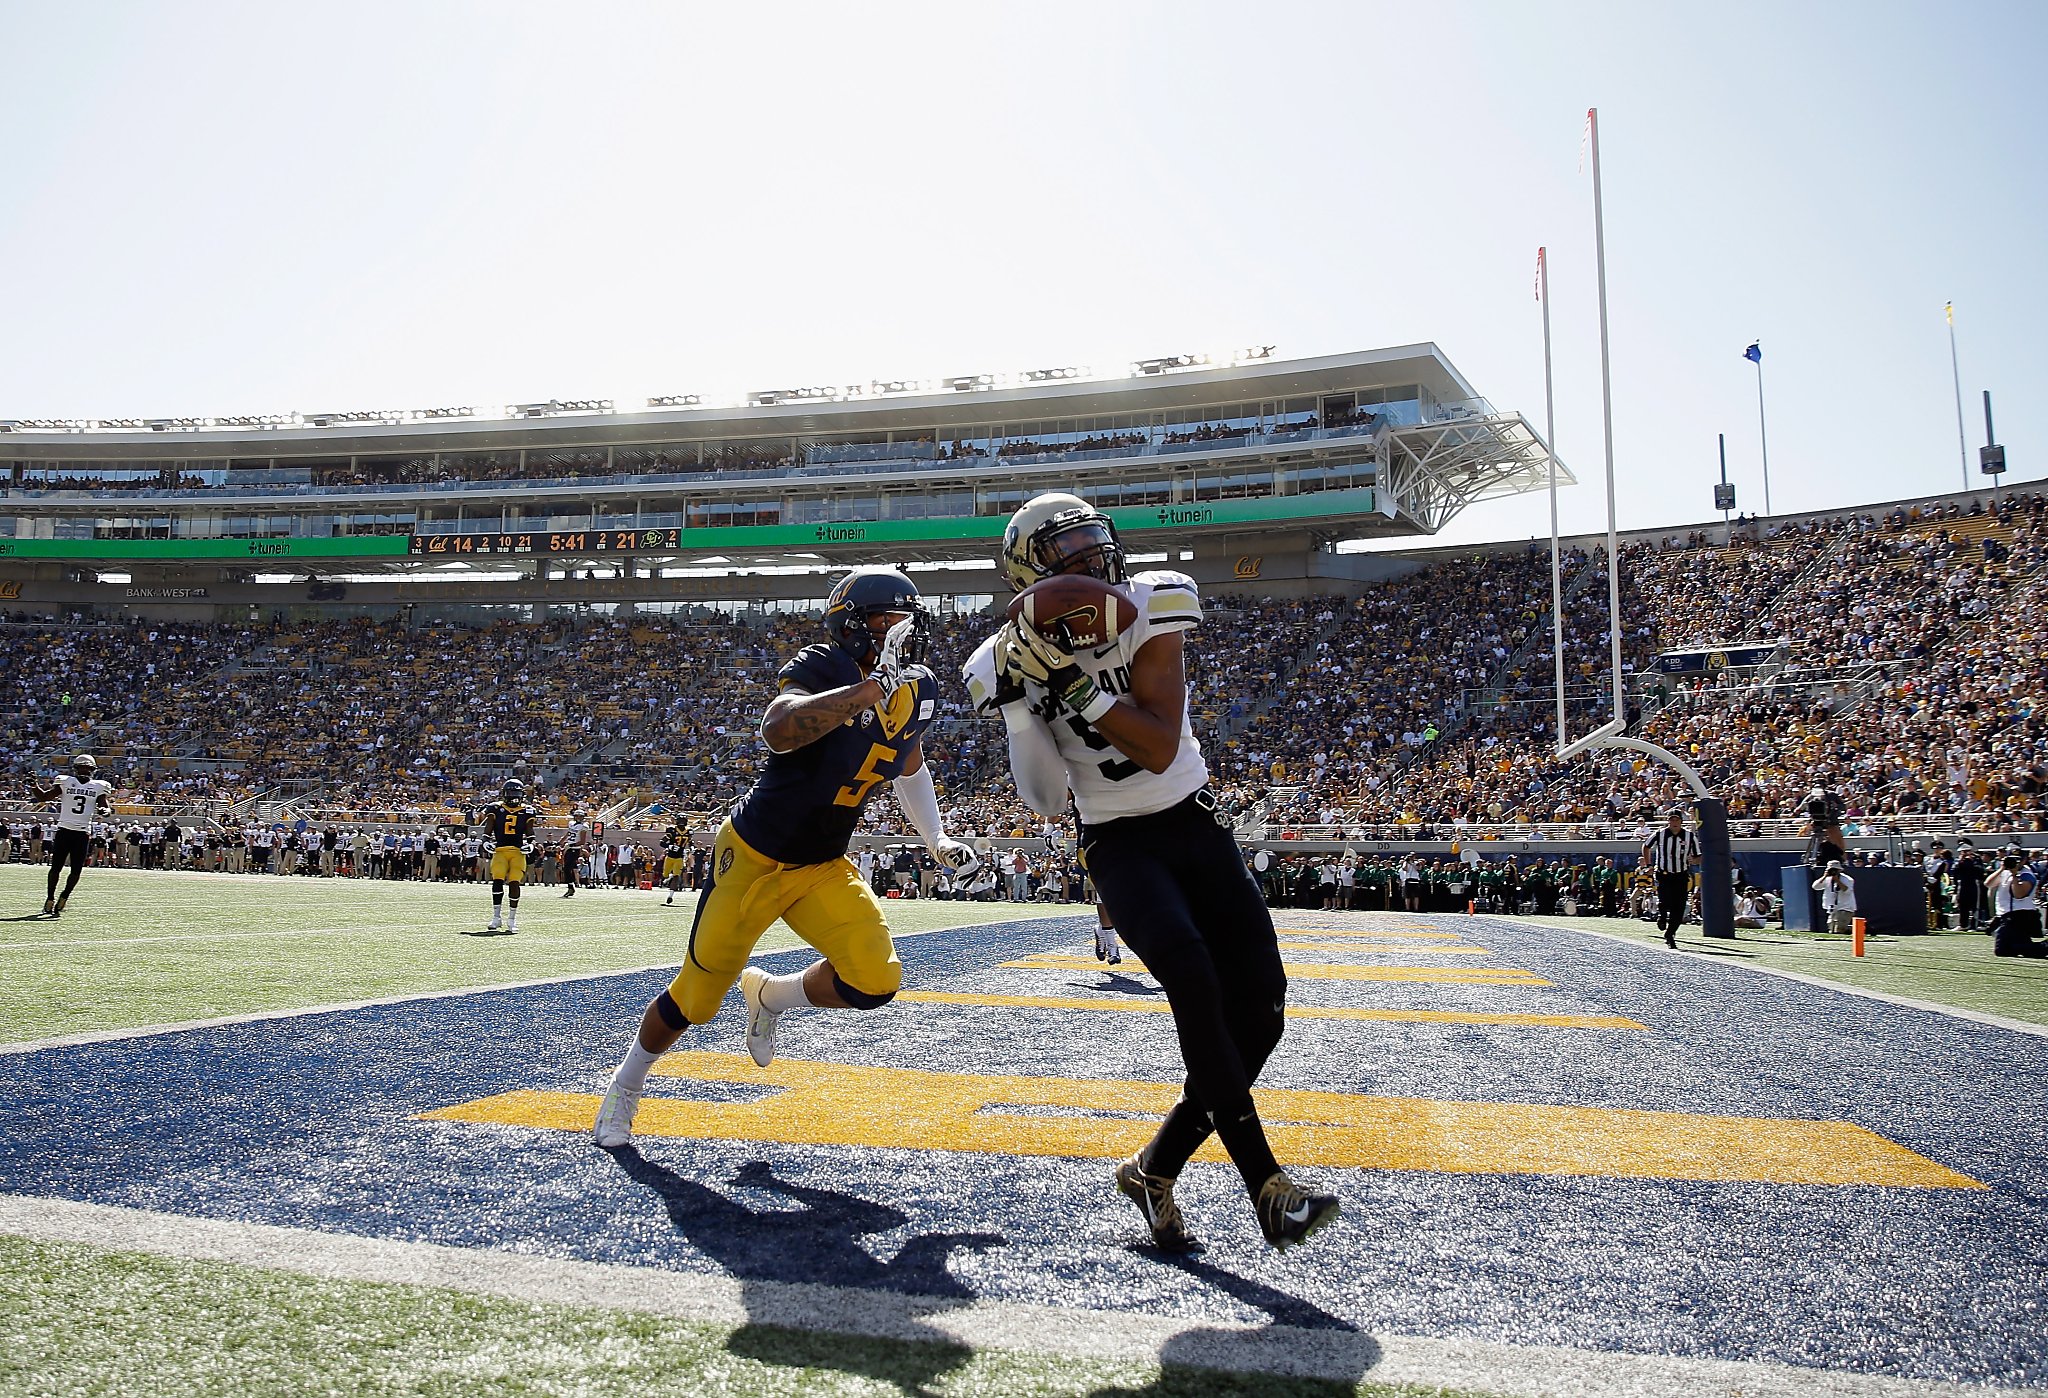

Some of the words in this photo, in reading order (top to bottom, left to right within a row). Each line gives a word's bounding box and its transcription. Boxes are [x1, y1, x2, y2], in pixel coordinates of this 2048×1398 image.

[1171, 506, 1213, 524] tunein
[415, 537, 423, 547] 3
[428, 535, 448, 552] Cal
[453, 537, 472, 553] 14
[482, 536, 489, 547] 2
[498, 536, 511, 546] 10
[518, 535, 531, 546] 21
[550, 533, 585, 551] 5:41
[599, 532, 607, 543] 2
[616, 532, 635, 549] 21
[669, 530, 677, 541] 2
[828, 525, 865, 540] tunein
[258, 541, 291, 555] tunein
[1233, 556, 1262, 579] Cal
[126, 588, 154, 597] BANK
[162, 588, 191, 597] WEST
[832, 742, 897, 808] 5
[66, 788, 97, 798] COLORADO
[72, 795, 87, 814] 3
[504, 814, 517, 835] 2
[594, 822, 603, 835] 2
